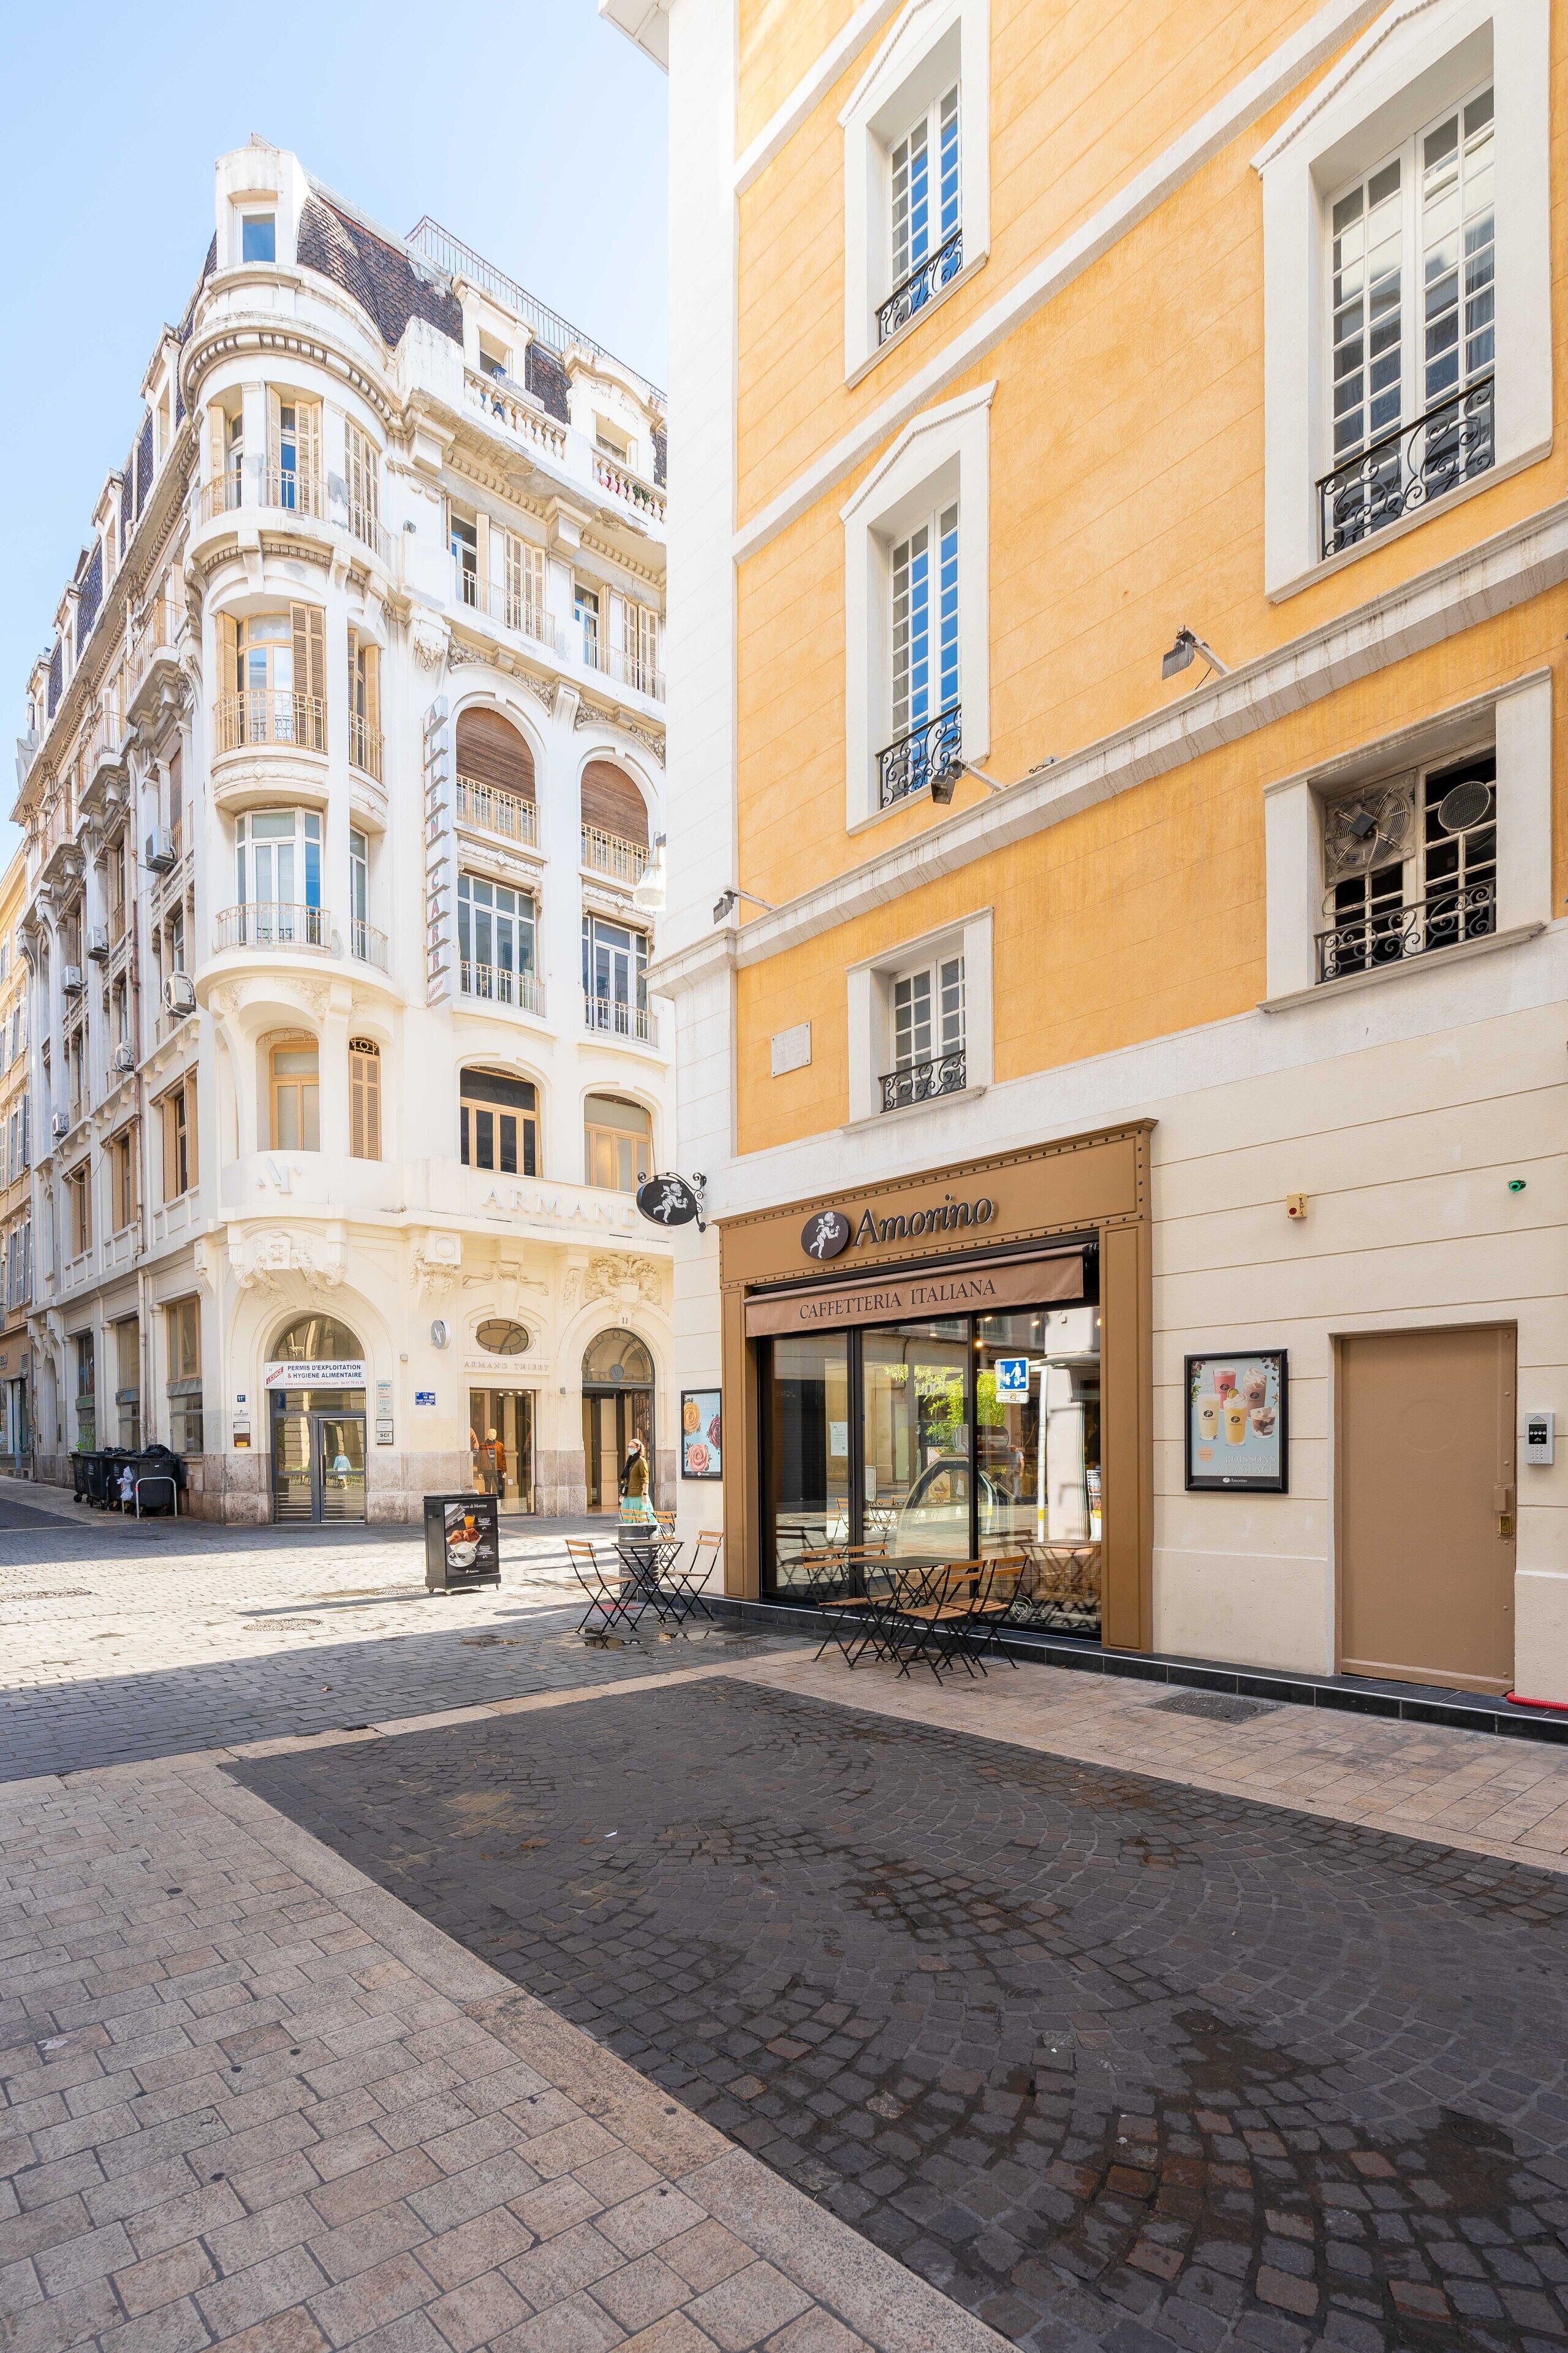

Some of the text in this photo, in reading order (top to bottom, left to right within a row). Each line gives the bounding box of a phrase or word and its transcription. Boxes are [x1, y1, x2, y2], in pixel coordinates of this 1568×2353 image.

[482, 1186, 640, 1227] ARMAND
[852, 1194, 994, 1248] Amorino
[800, 1278, 997, 1319] CAFFETTERIA ITALIANA
[464, 1360, 508, 1370] ARMAND
[1225, 1455, 1276, 1464] BOISSONS
[1225, 1466, 1239, 1474] LA
[1241, 1465, 1276, 1475] GLACE
